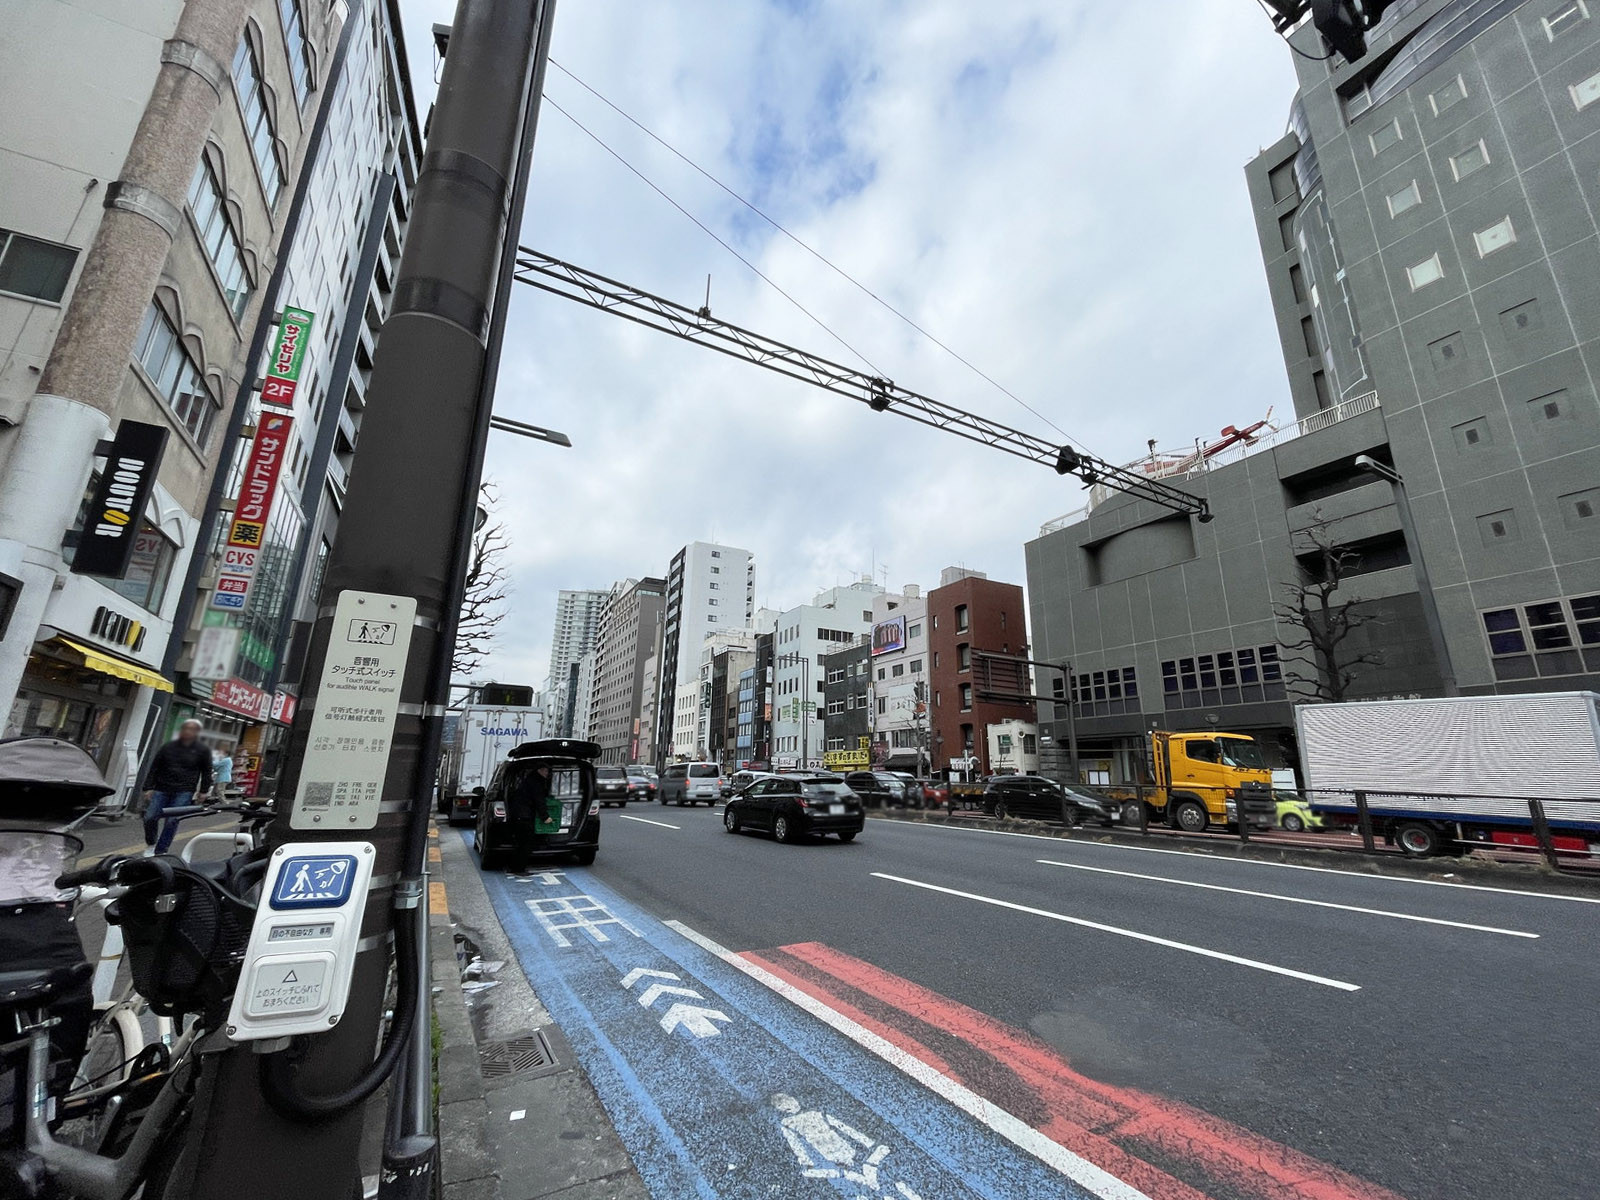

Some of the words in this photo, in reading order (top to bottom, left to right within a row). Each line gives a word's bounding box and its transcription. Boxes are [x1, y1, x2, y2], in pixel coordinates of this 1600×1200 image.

[276, 324, 300, 373] サイゼリヤ
[266, 383, 293, 397] 2F
[241, 437, 280, 520] サンドラッグ
[95, 457, 145, 538] DOUTOR
[233, 522, 259, 543] 薬
[226, 550, 255, 566] CVS
[221, 580, 245, 591] 弁当
[353, 656, 380, 667] 音響用
[331, 665, 397, 678] タッチ式スイッチ
[480, 727, 528, 736] SAGAWA
[255, 984, 320, 998] 上のスイッチにふれて
[262, 995, 309, 1007] おまちください
